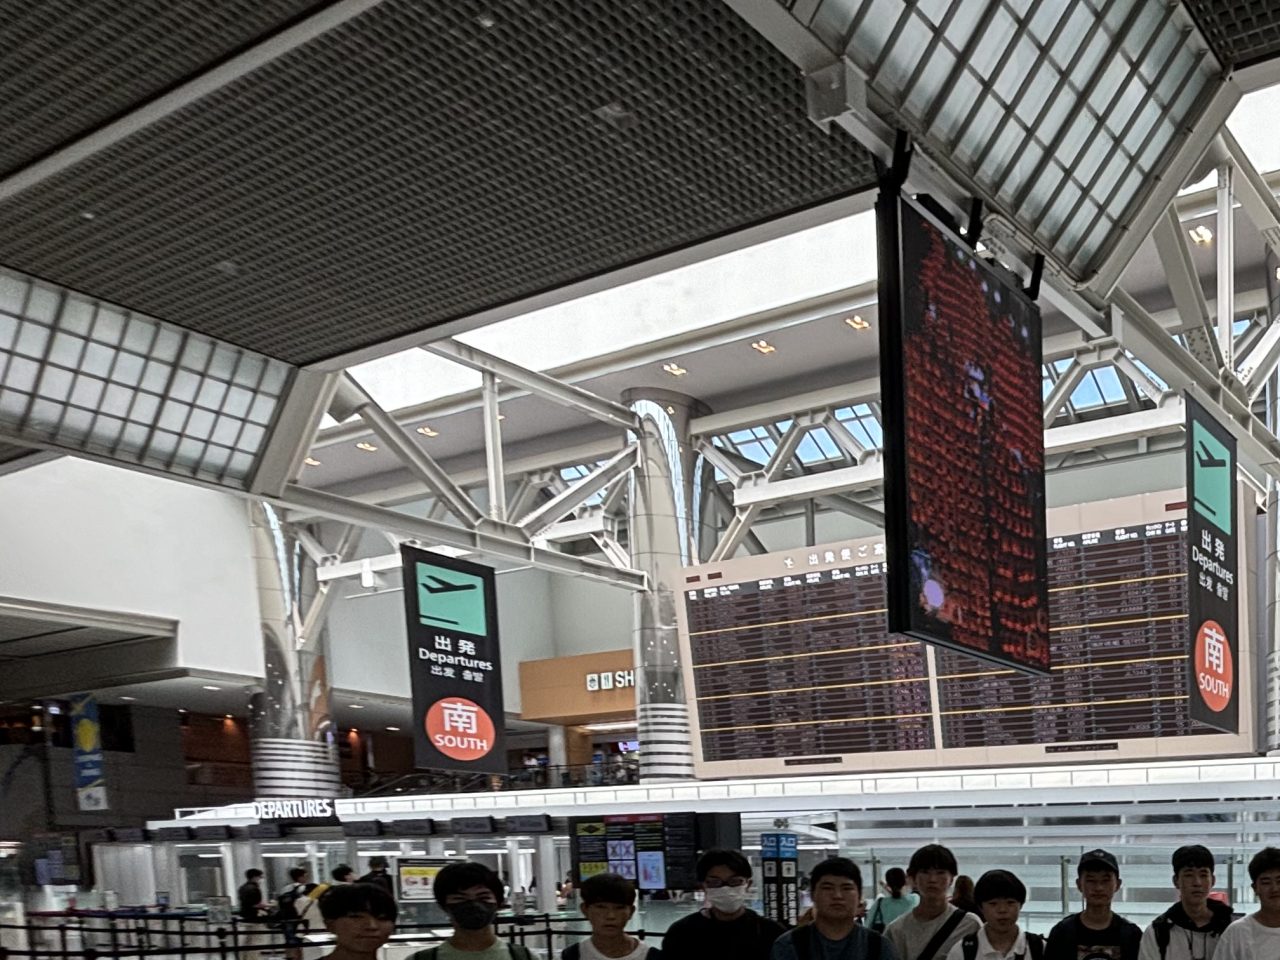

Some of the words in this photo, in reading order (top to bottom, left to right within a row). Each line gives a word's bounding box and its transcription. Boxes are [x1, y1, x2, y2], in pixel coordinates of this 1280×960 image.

[1201, 529, 1225, 561] 出発
[1192, 545, 1234, 585] Departures
[434, 635, 476, 656] 出発
[1203, 627, 1224, 674] 南
[418, 648, 494, 671] Departures
[1199, 672, 1229, 698] SOUTH
[441, 702, 479, 734] 南
[434, 734, 488, 751] SOUTH
[252, 799, 333, 819] DEPARTURES
